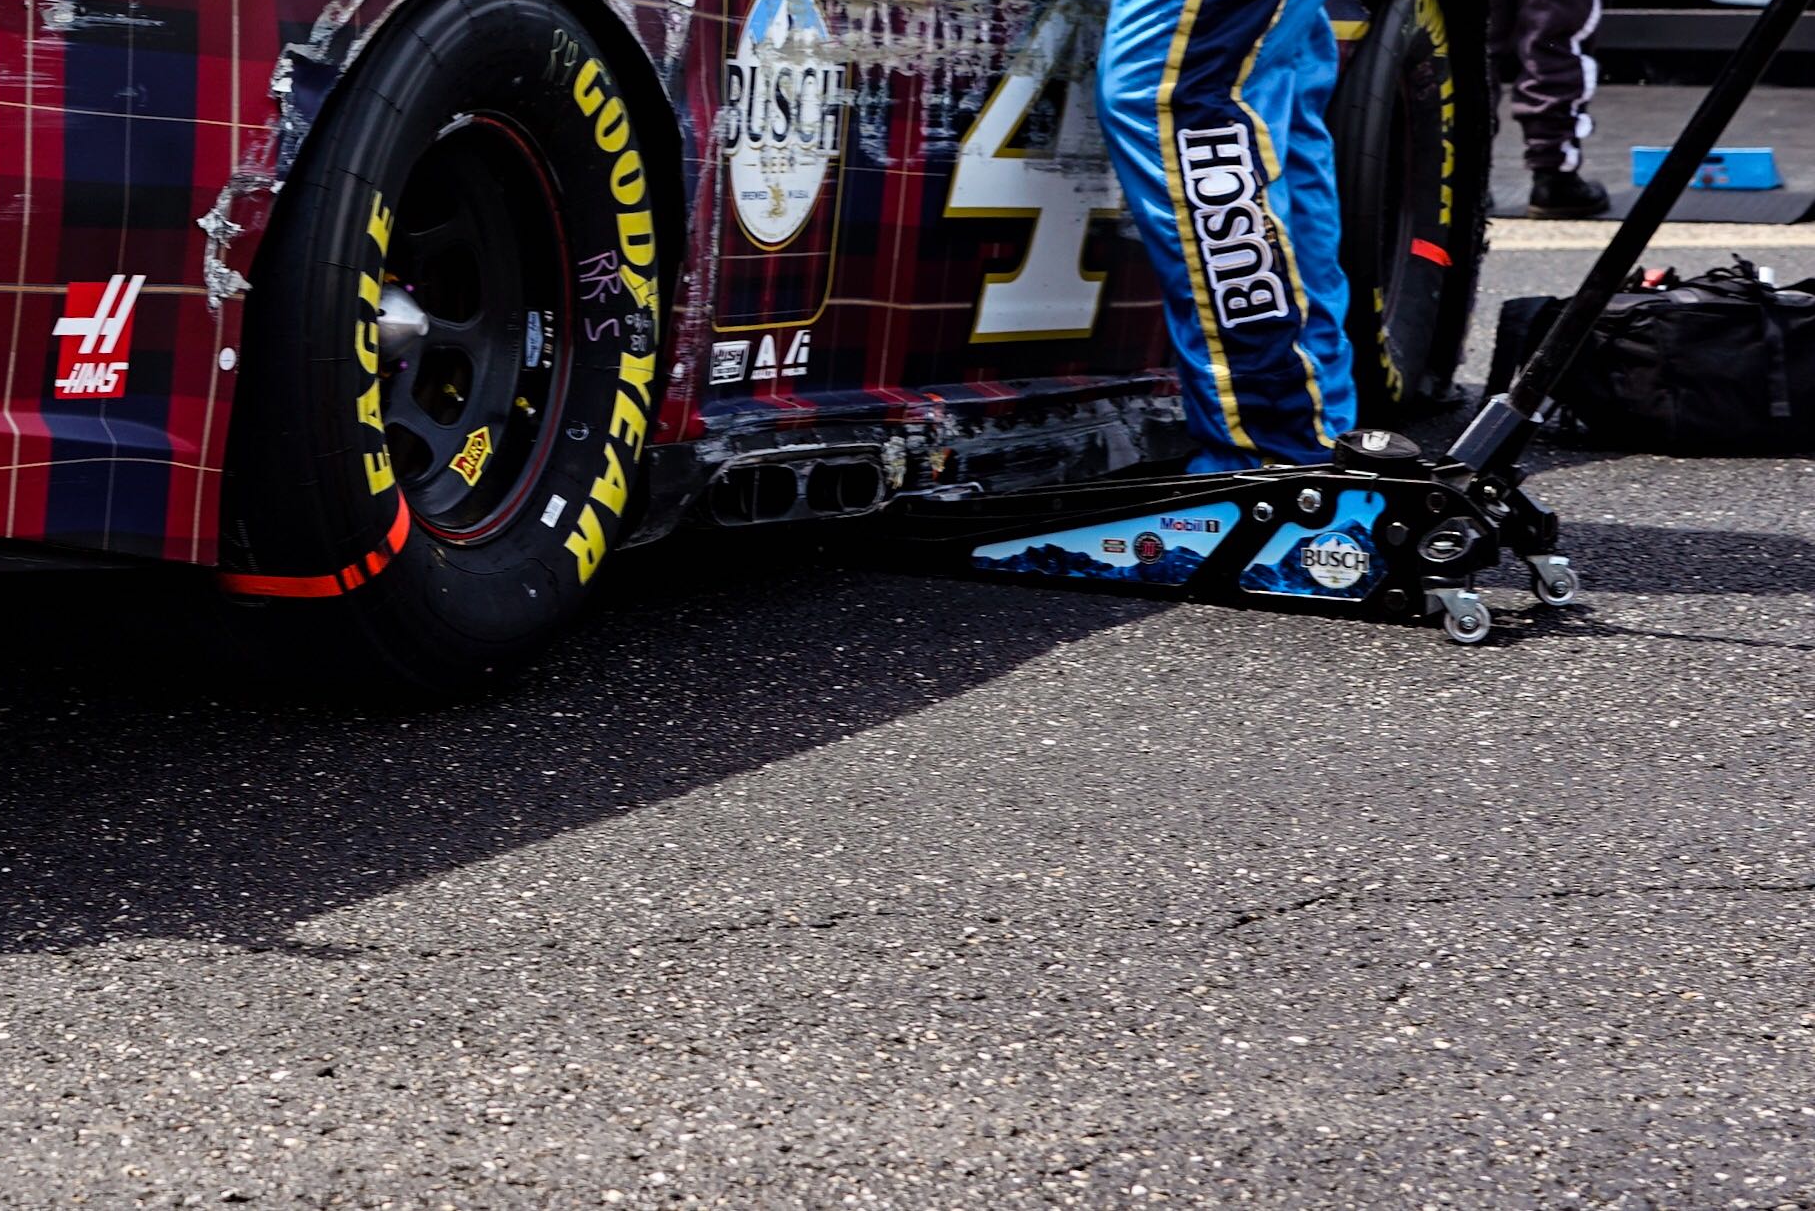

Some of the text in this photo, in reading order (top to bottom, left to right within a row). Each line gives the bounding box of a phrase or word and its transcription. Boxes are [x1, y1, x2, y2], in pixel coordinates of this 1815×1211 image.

[725, 61, 846, 157] BUSCH
[1177, 123, 1289, 328] BUSCH
[354, 189, 396, 496] EAGLE
[54, 361, 130, 394] HAAS
[1159, 516, 1204, 533] Mobil
[1301, 547, 1370, 574] BUSCH
